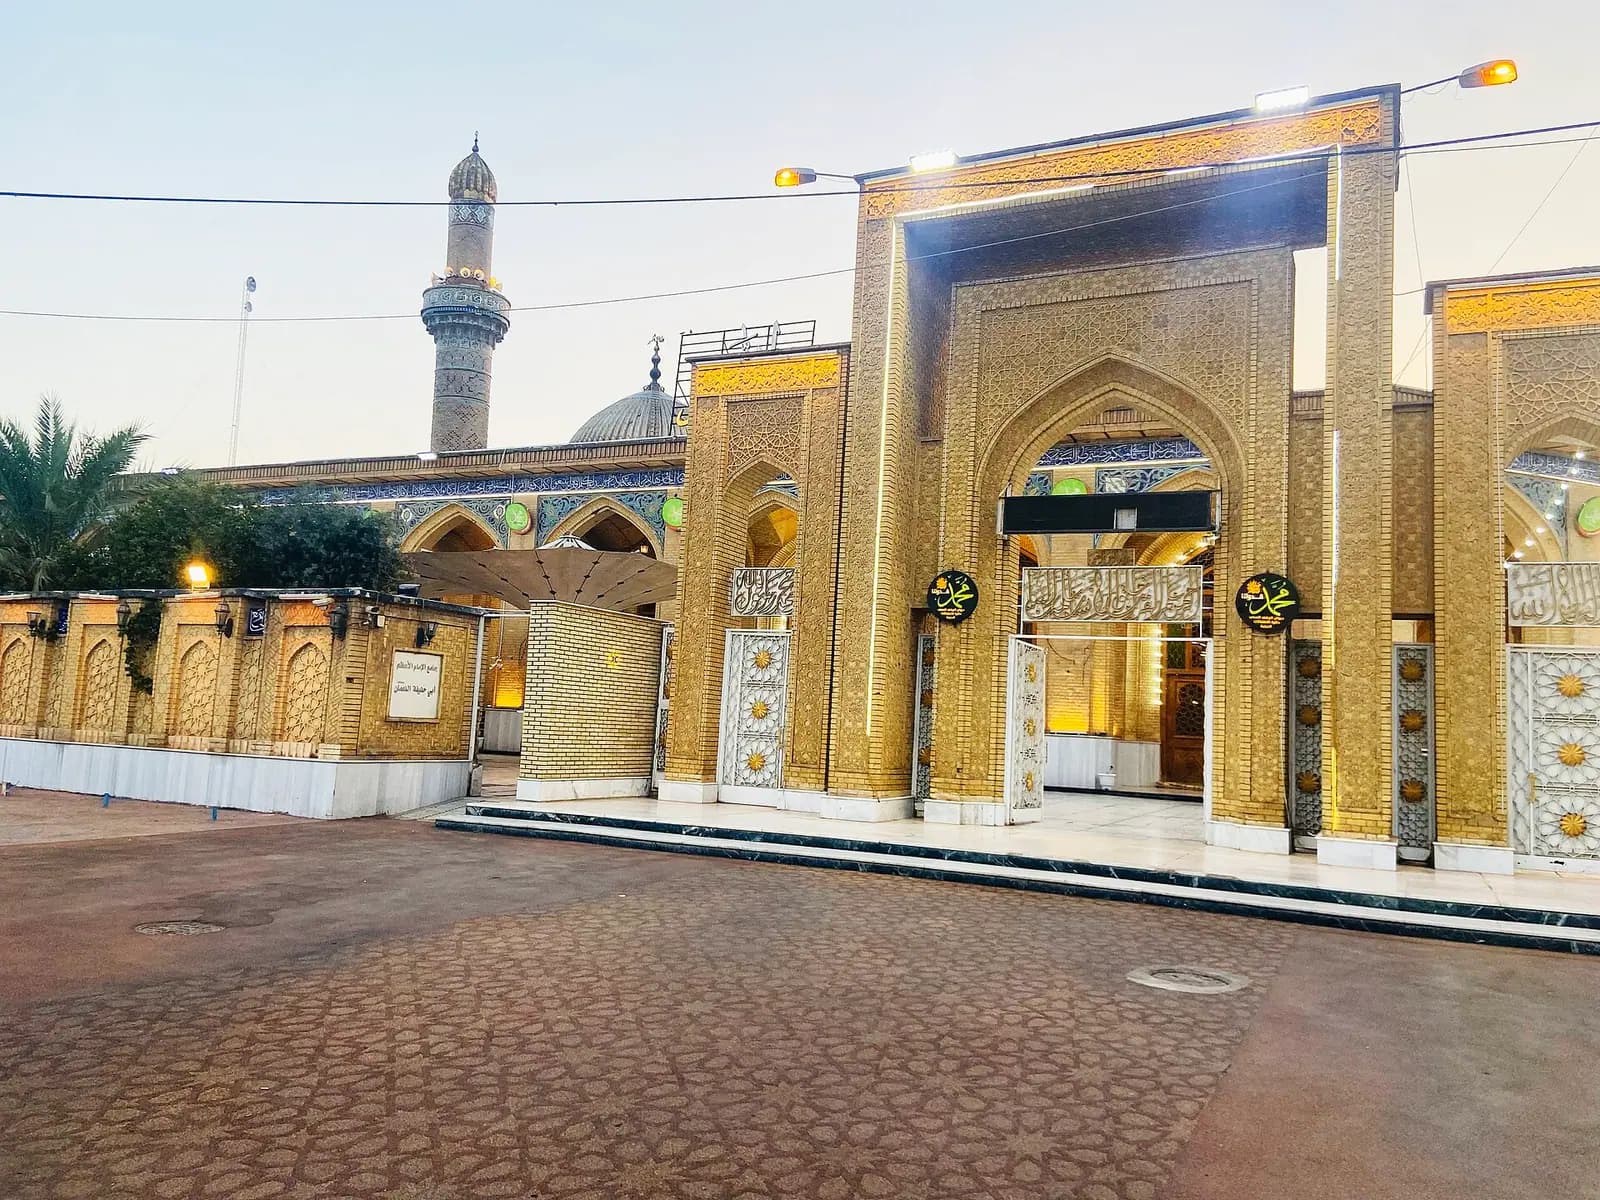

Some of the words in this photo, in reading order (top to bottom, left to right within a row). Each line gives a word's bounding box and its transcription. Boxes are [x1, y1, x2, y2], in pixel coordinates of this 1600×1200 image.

[937, 577, 974, 608] محمد
[1248, 581, 1297, 616] محمد
[412, 685, 427, 695] حنيفة
